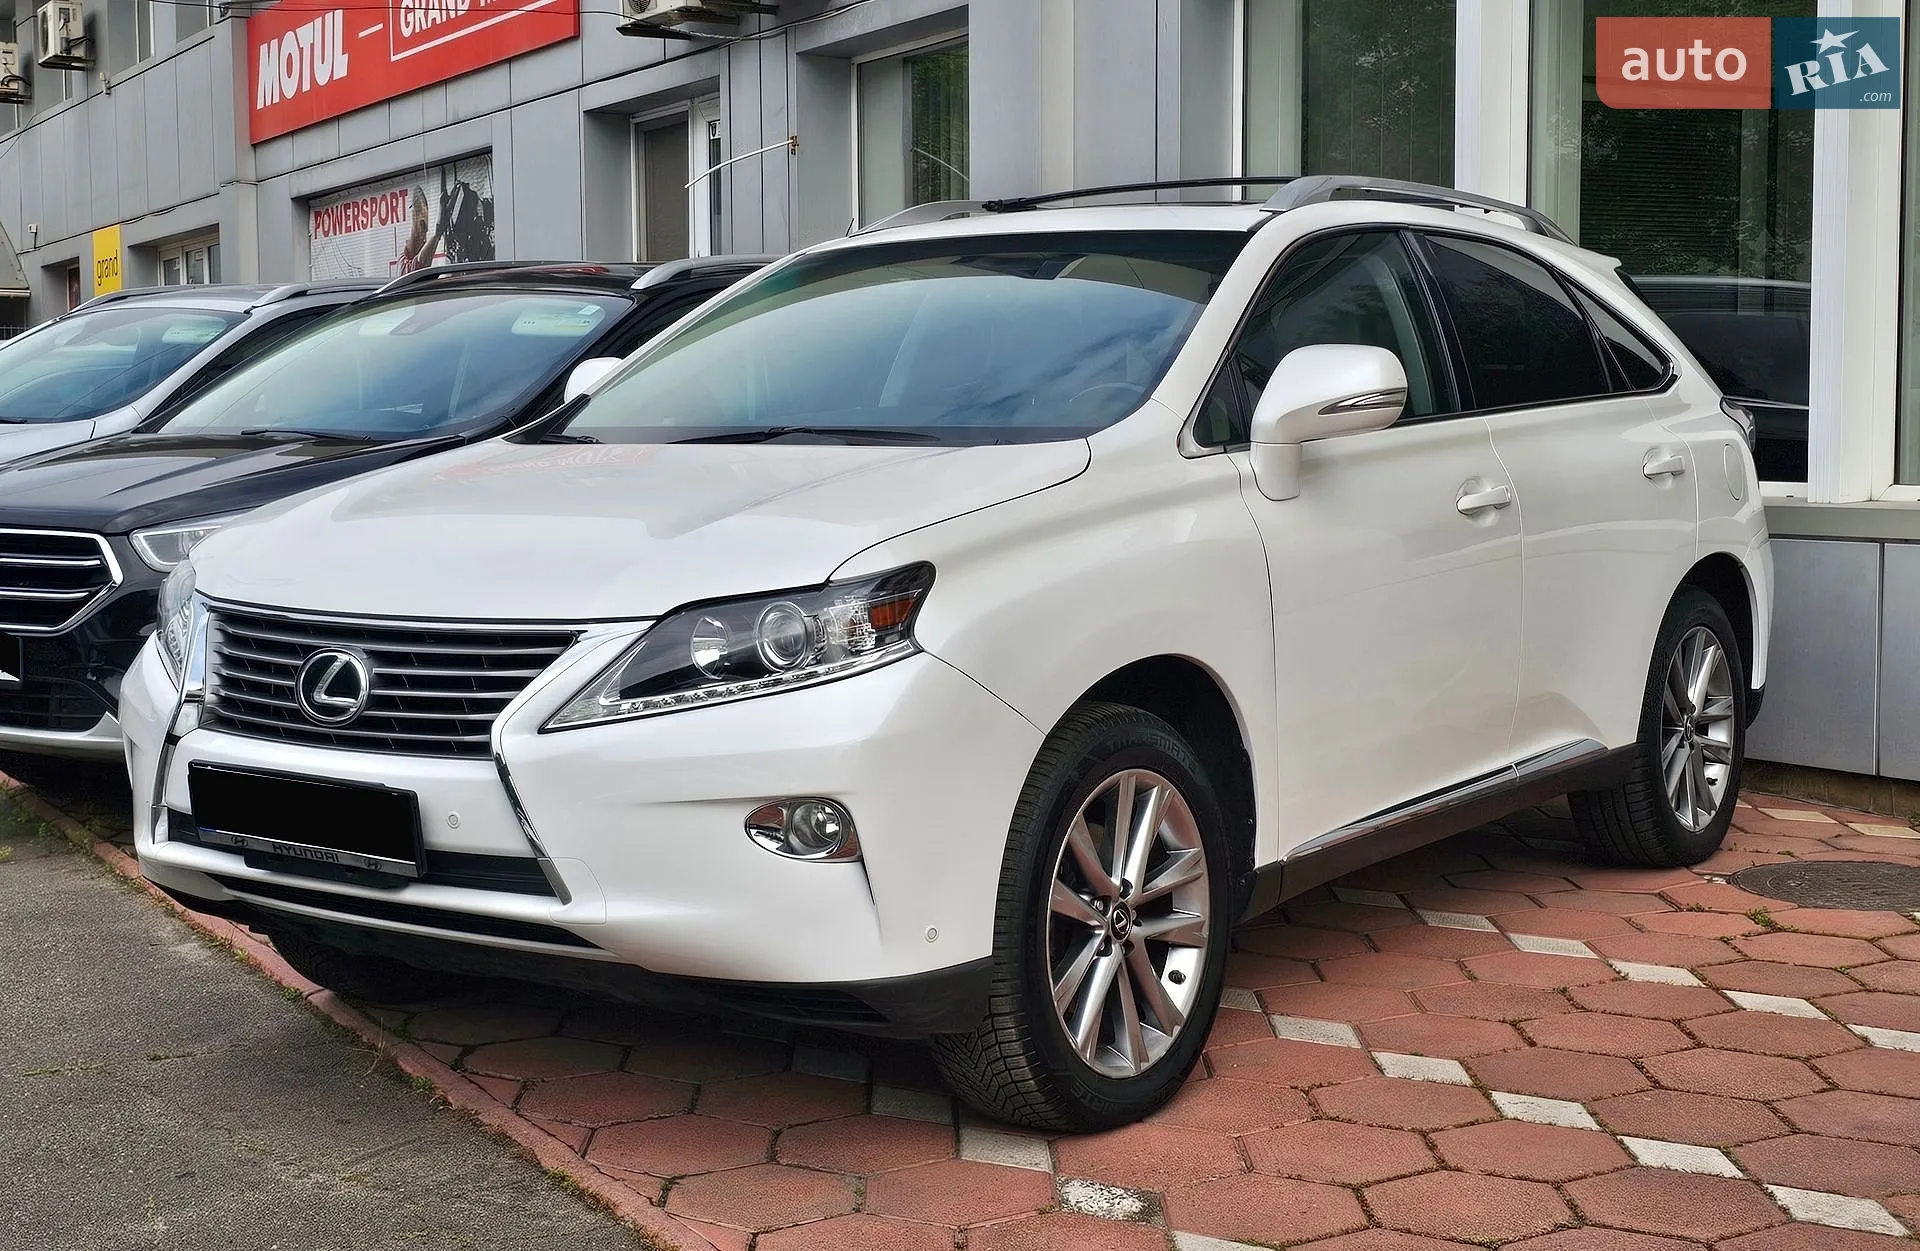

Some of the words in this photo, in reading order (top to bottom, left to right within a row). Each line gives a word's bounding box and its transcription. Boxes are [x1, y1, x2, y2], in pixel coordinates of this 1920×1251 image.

[257, 9, 349, 110] MOTUL
[314, 188, 408, 239] POWERSPORT
[96, 249, 118, 286] grand
[271, 843, 340, 863] HYUNDAI
